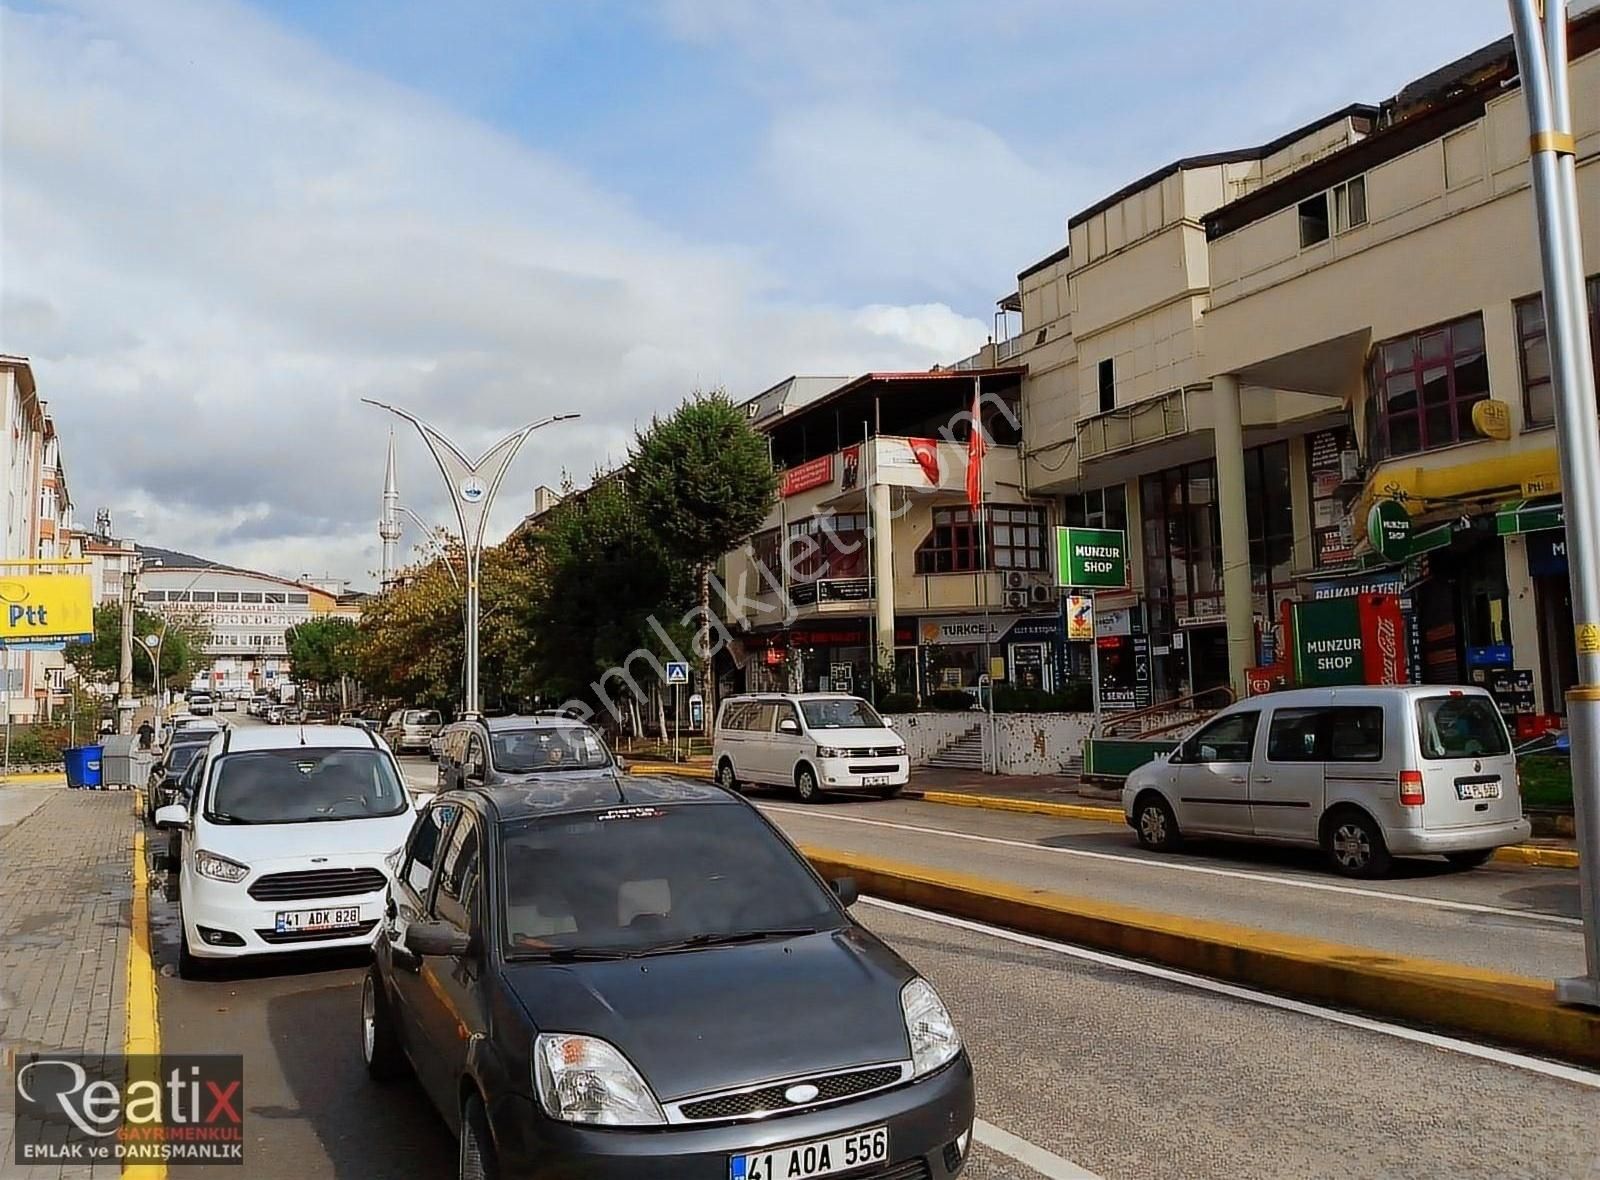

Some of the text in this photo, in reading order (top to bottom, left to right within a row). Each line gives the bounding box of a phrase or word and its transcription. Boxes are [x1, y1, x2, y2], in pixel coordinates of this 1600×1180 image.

[1075, 545, 1120, 559] MUNZUR
[1084, 561, 1113, 573] SHOP
[9, 604, 48, 627] Ptt
[1307, 638, 1362, 653] MUNZUR
[1317, 657, 1353, 670] SHOP
[285, 909, 357, 927] 41 ADK 828
[748, 1154, 773, 1180] 41
[845, 1131, 886, 1166] 556
